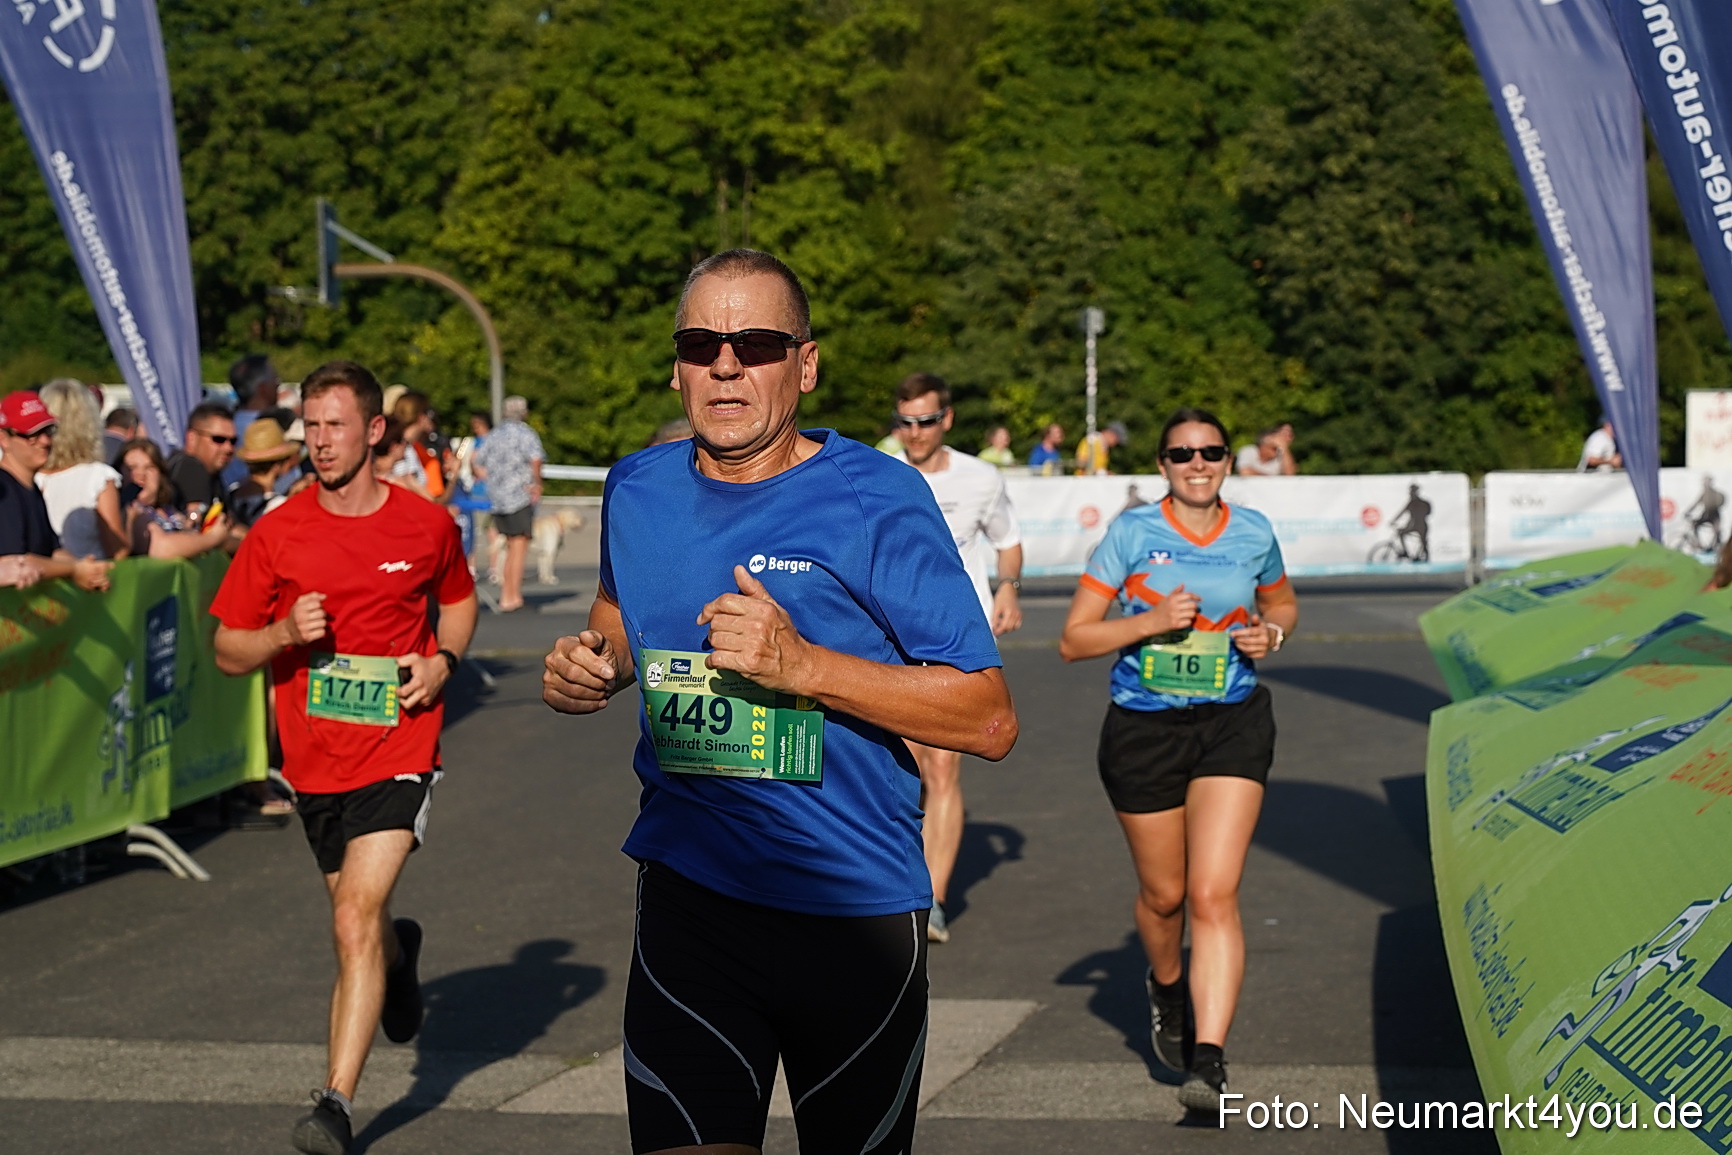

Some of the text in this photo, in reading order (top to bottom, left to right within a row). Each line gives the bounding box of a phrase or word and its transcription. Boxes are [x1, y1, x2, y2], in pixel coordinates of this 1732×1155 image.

[768, 556, 813, 574] Berger
[1172, 654, 1200, 675] 16
[663, 673, 707, 683] Firmenlauf
[325, 677, 384, 701] 1717
[659, 693, 733, 735] 449
[751, 706, 766, 760] 2022
[704, 739, 750, 754] Simon
